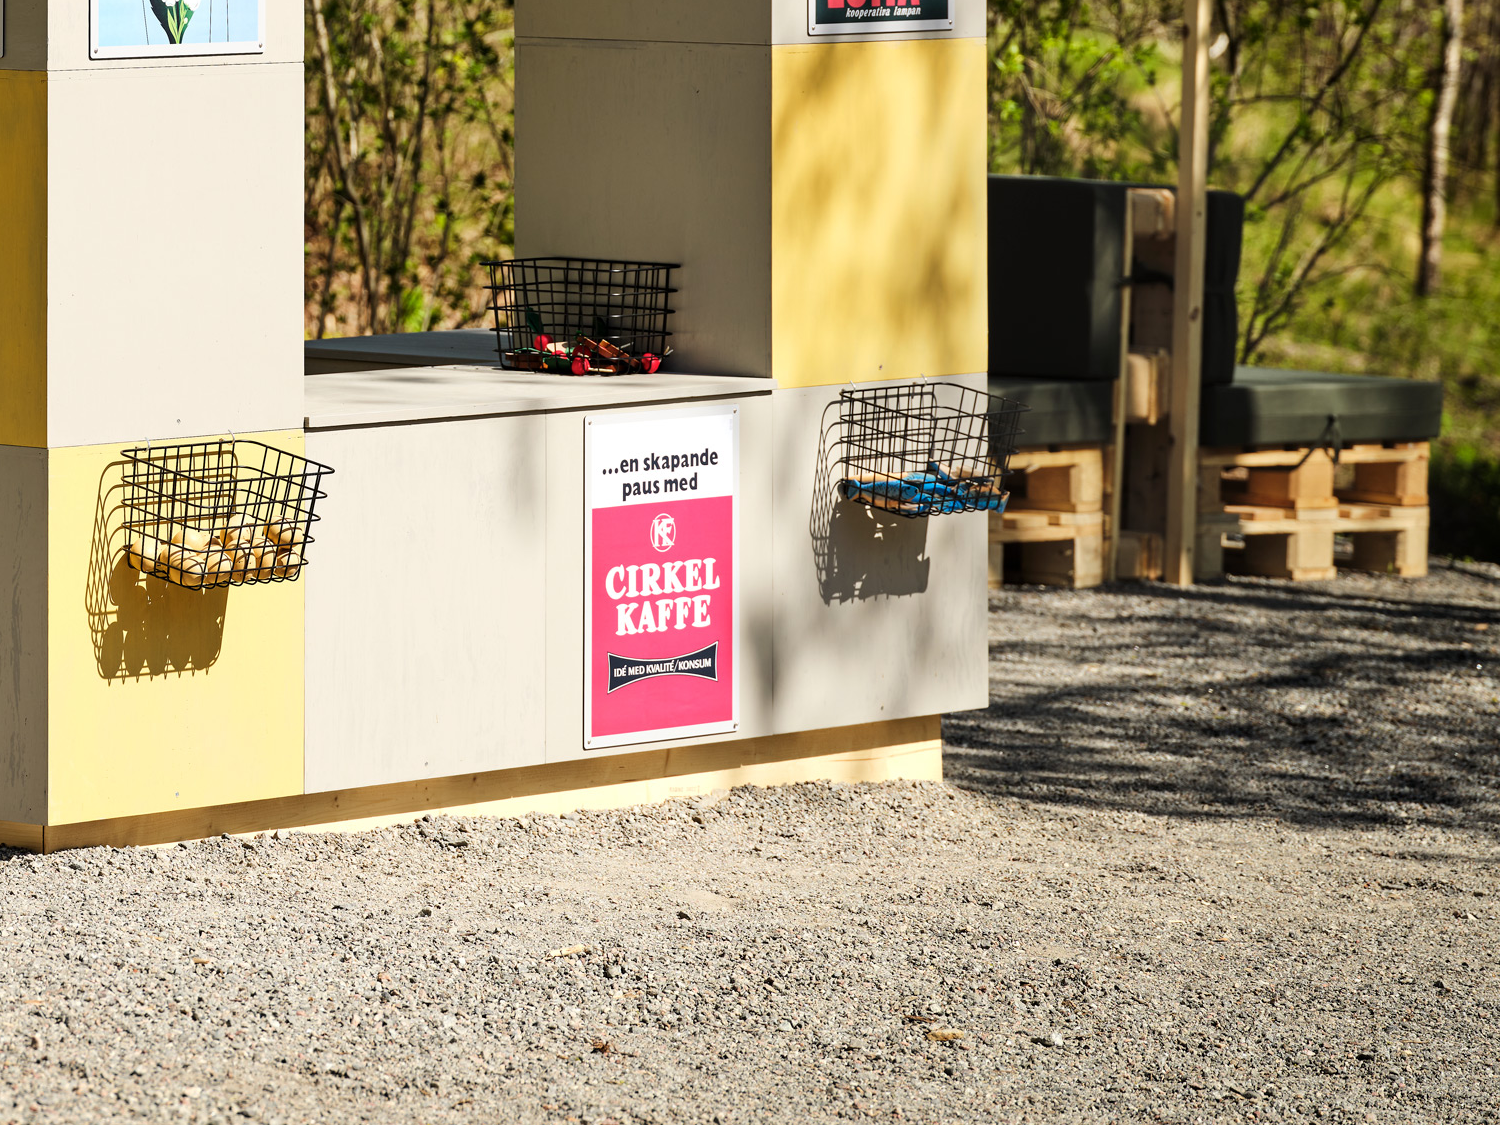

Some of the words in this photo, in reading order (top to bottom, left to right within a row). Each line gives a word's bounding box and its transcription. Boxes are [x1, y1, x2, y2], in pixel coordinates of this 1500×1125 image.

[845, 6, 891, 19] kooperativa
[893, 6, 921, 17] lampan
[643, 448, 718, 472] skapande
[622, 480, 660, 501] paus
[664, 472, 698, 493] med
[605, 557, 720, 600] CIRKEL
[615, 594, 711, 636] KAFFE
[613, 664, 627, 677] IDÉ
[628, 665, 645, 676] MED
